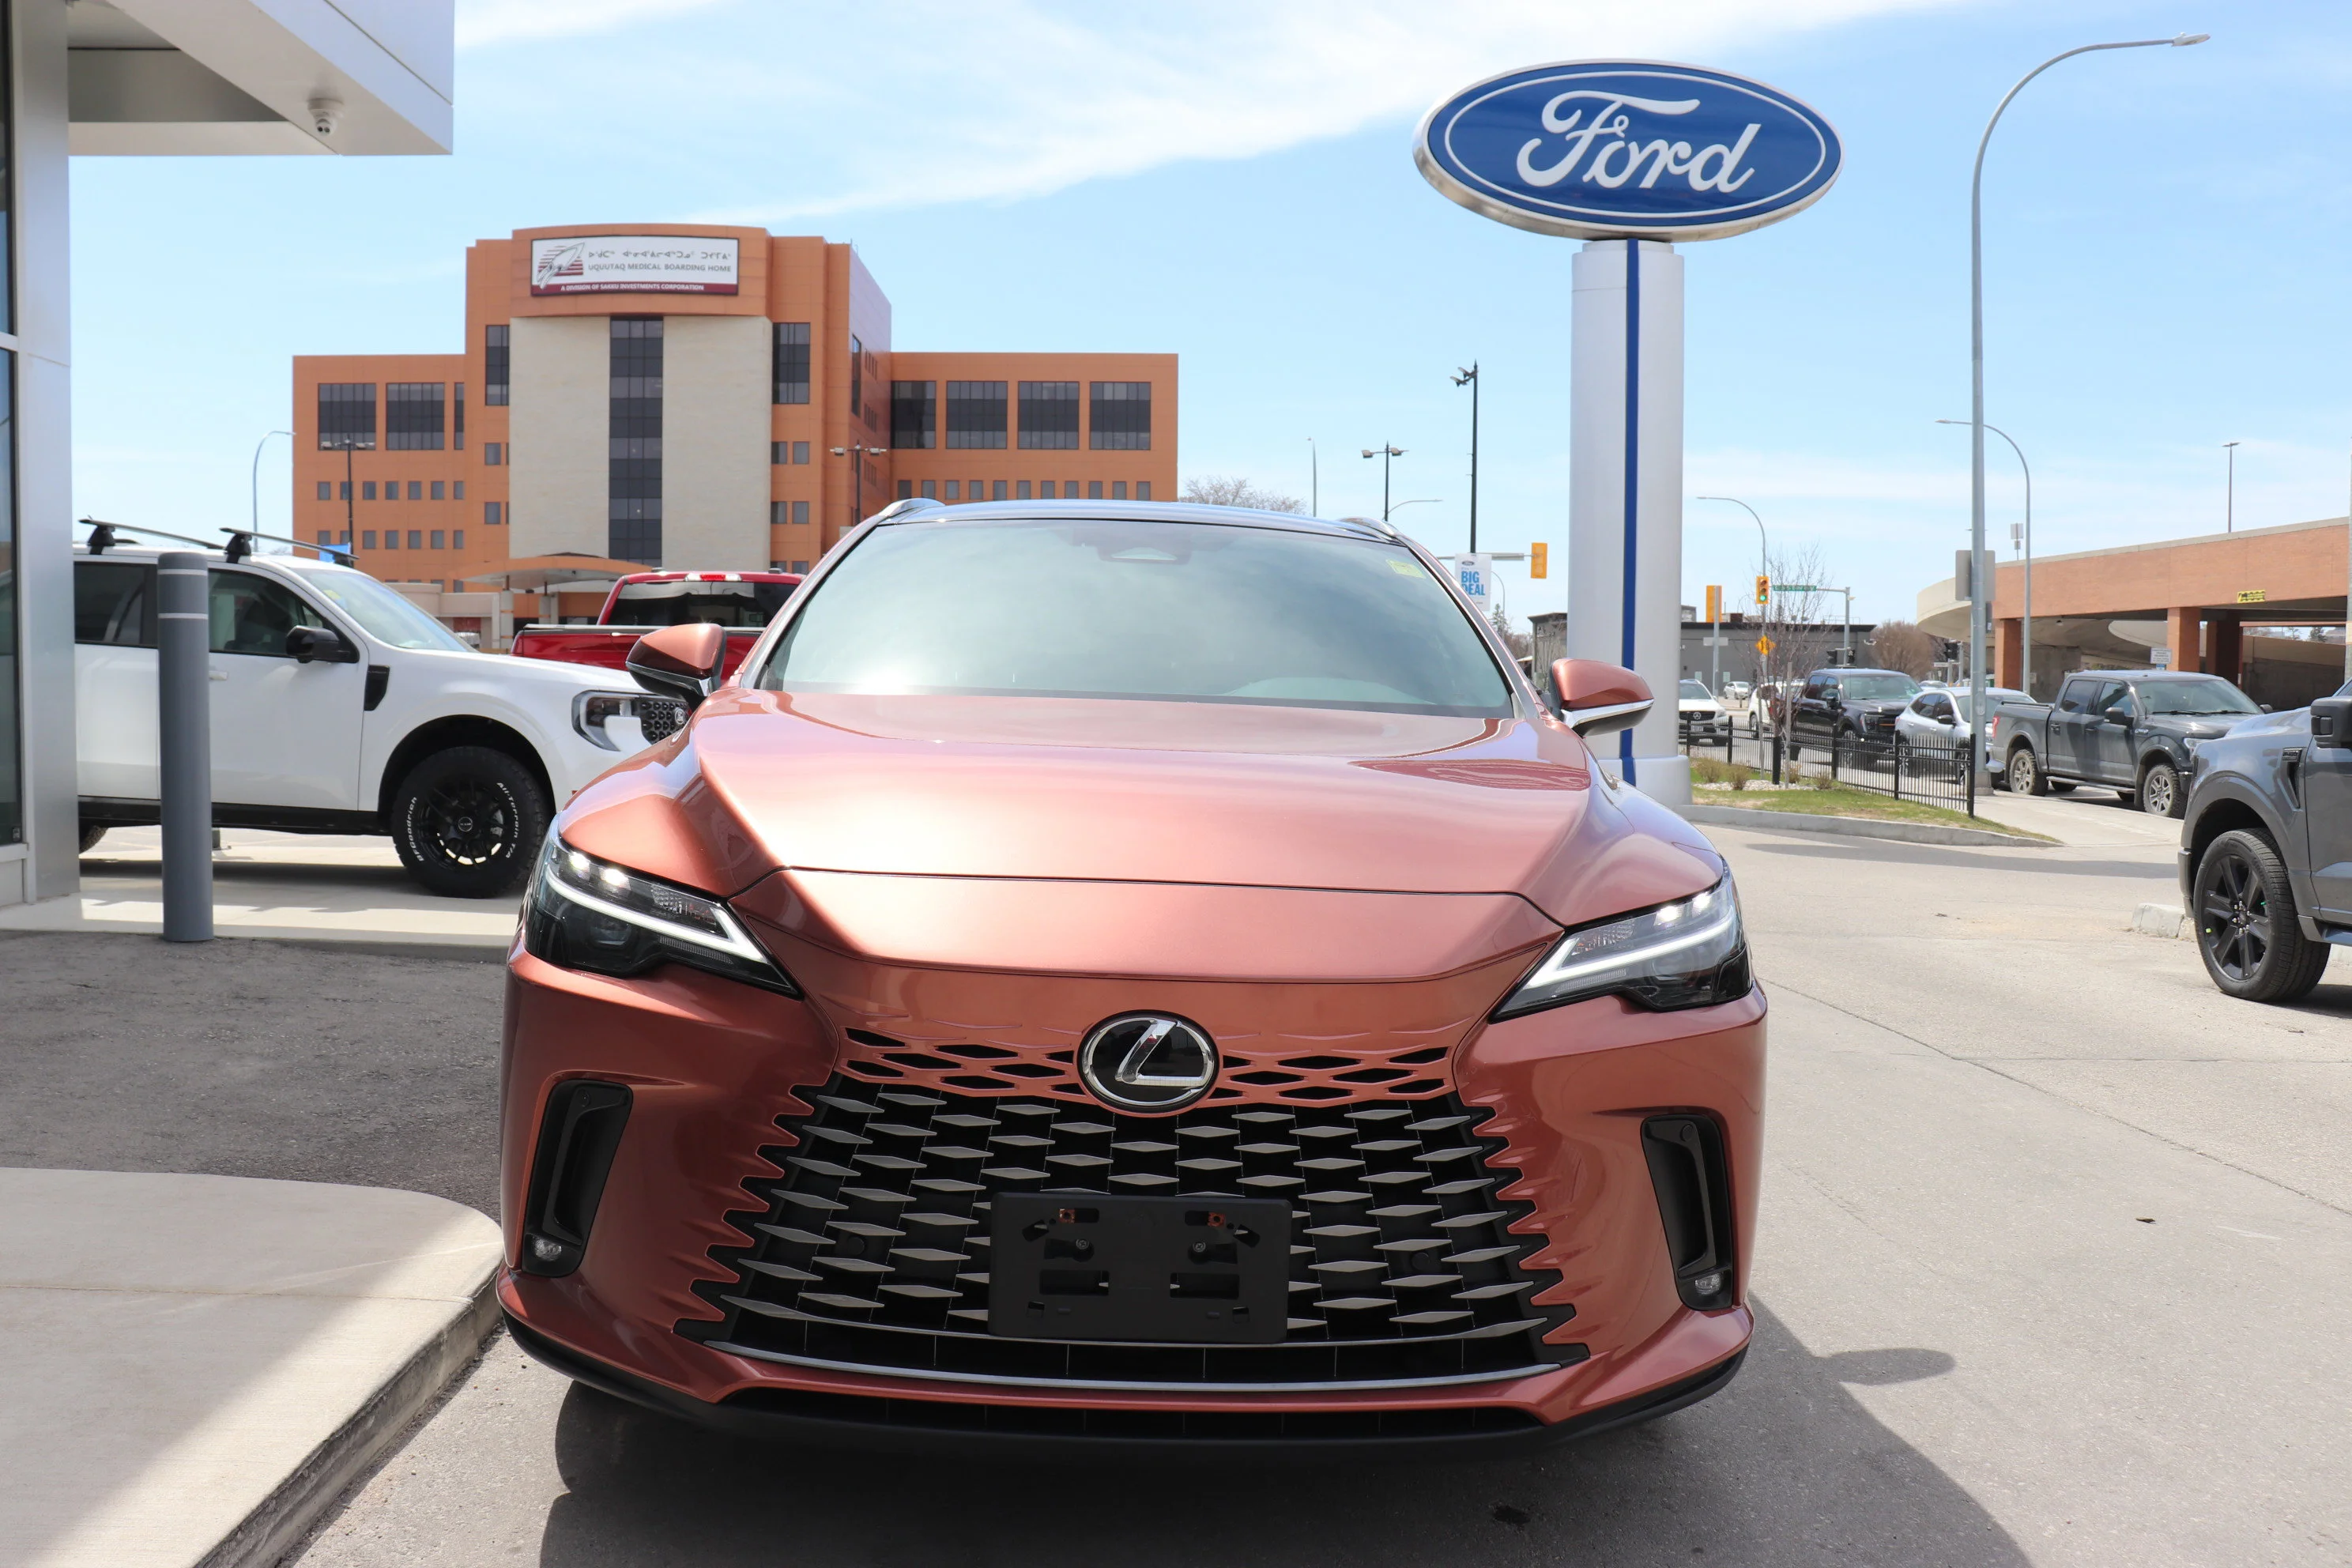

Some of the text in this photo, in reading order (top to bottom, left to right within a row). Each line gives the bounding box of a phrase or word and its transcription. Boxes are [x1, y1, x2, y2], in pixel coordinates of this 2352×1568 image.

[1516, 89, 1761, 194] Ford
[588, 262, 626, 272] UQUUTAQ
[664, 263, 706, 272] BOARDING
[1461, 571, 1479, 583] BIG
[1461, 583, 1485, 595] DEAL
[496, 782, 519, 839] All-Terrain
[406, 797, 424, 861] BFGoodrich
